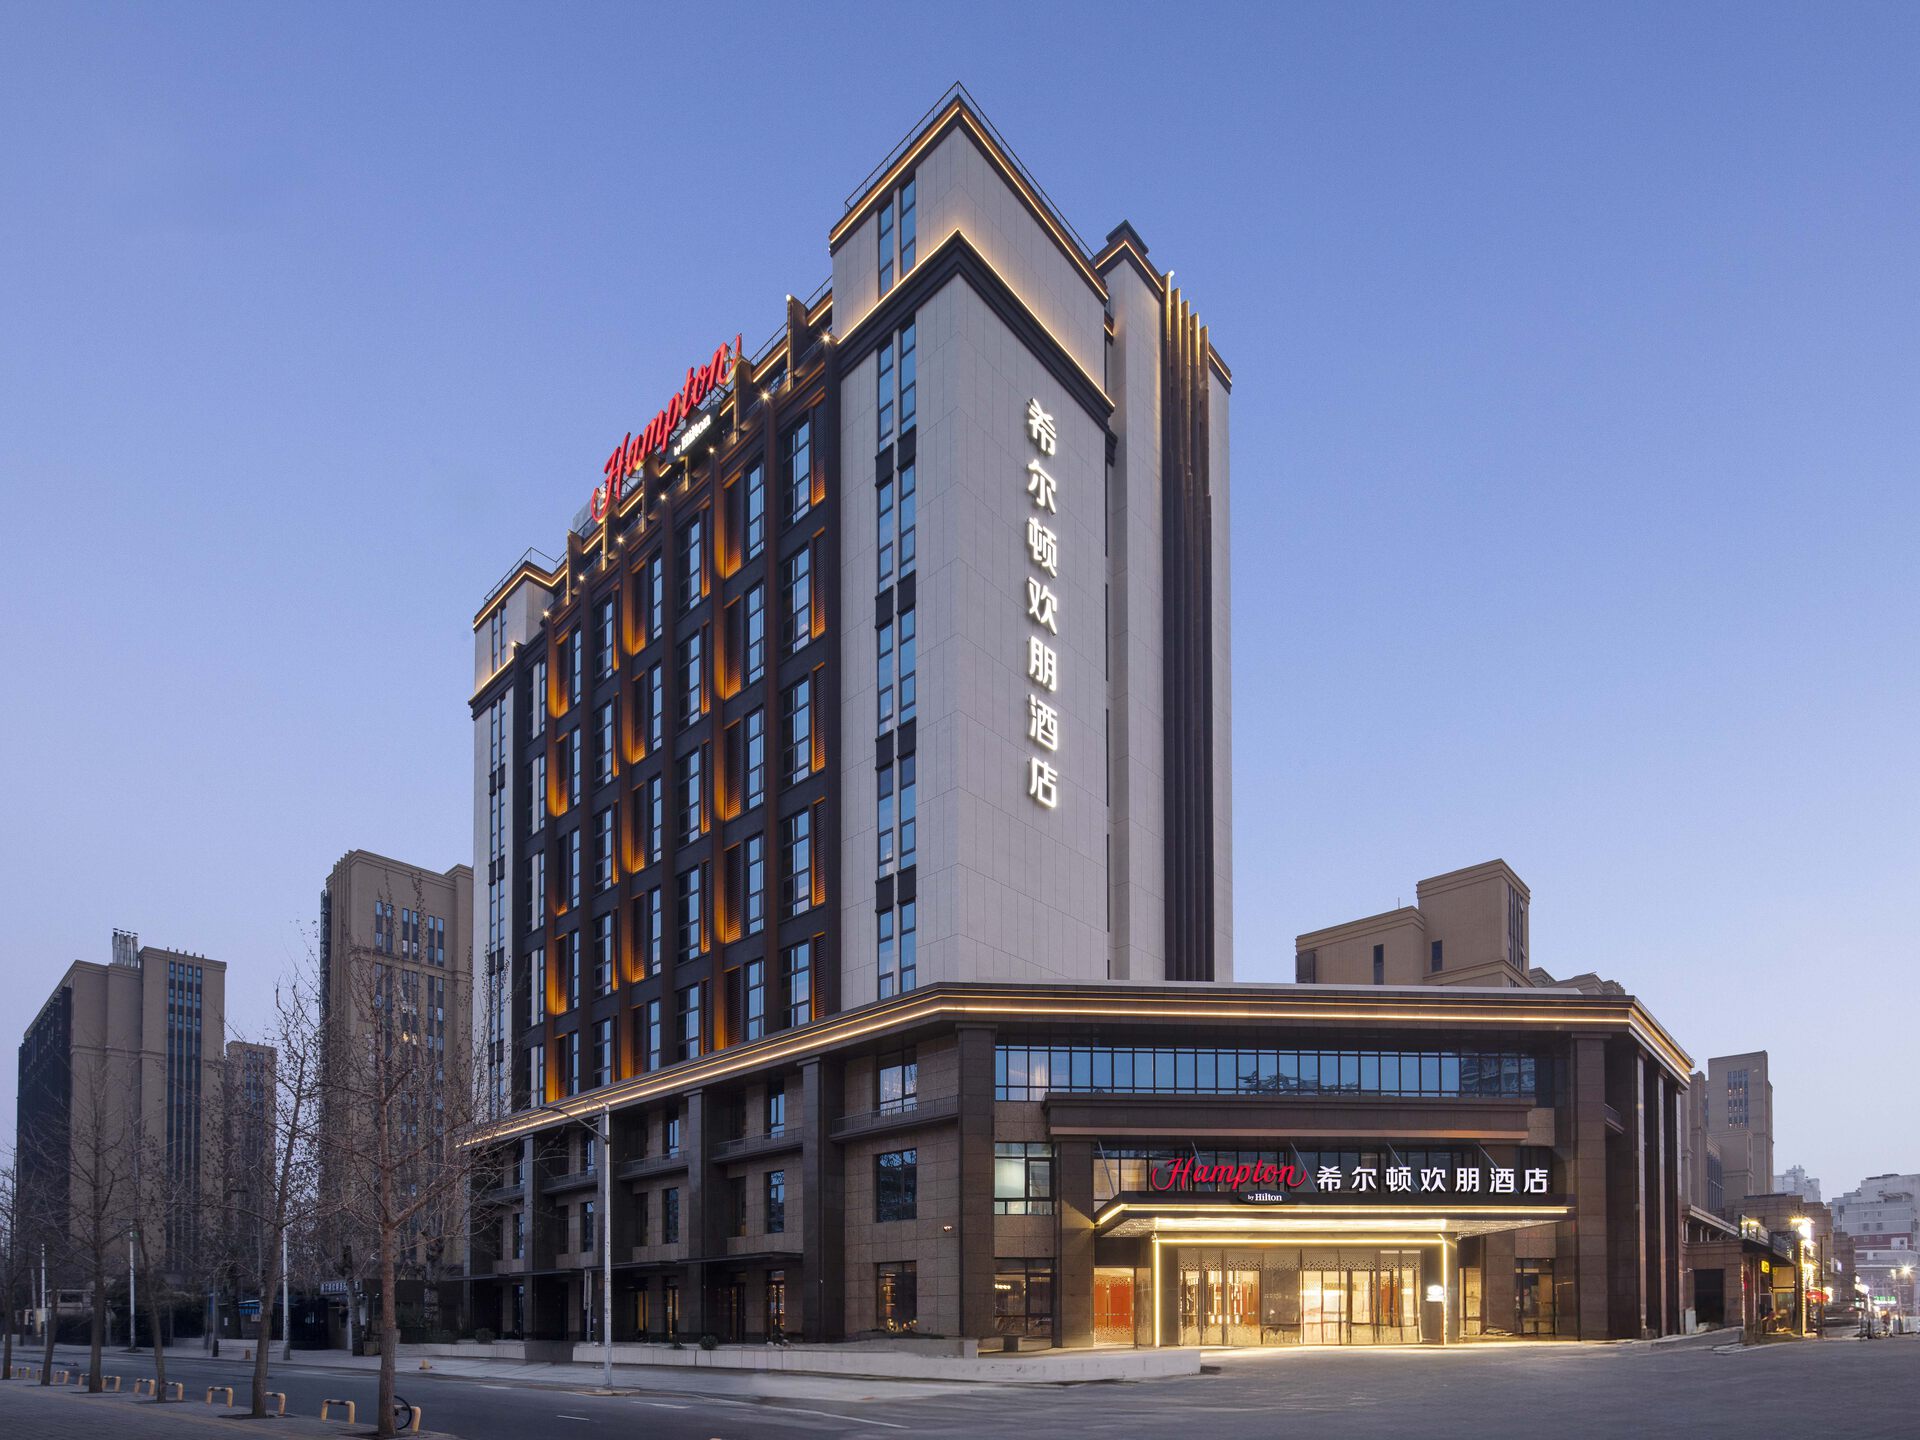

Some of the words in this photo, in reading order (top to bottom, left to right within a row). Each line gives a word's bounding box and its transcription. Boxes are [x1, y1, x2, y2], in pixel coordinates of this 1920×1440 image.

[591, 333, 742, 523] Hampton
[1026, 397, 1058, 809] 希尔顿欢朋酒店
[1151, 1156, 1307, 1191] Hampton
[1316, 1165, 1549, 1193] 希尔顿欢朋酒店
[1247, 1193, 1255, 1201] by
[1255, 1192, 1283, 1202] Hilton
